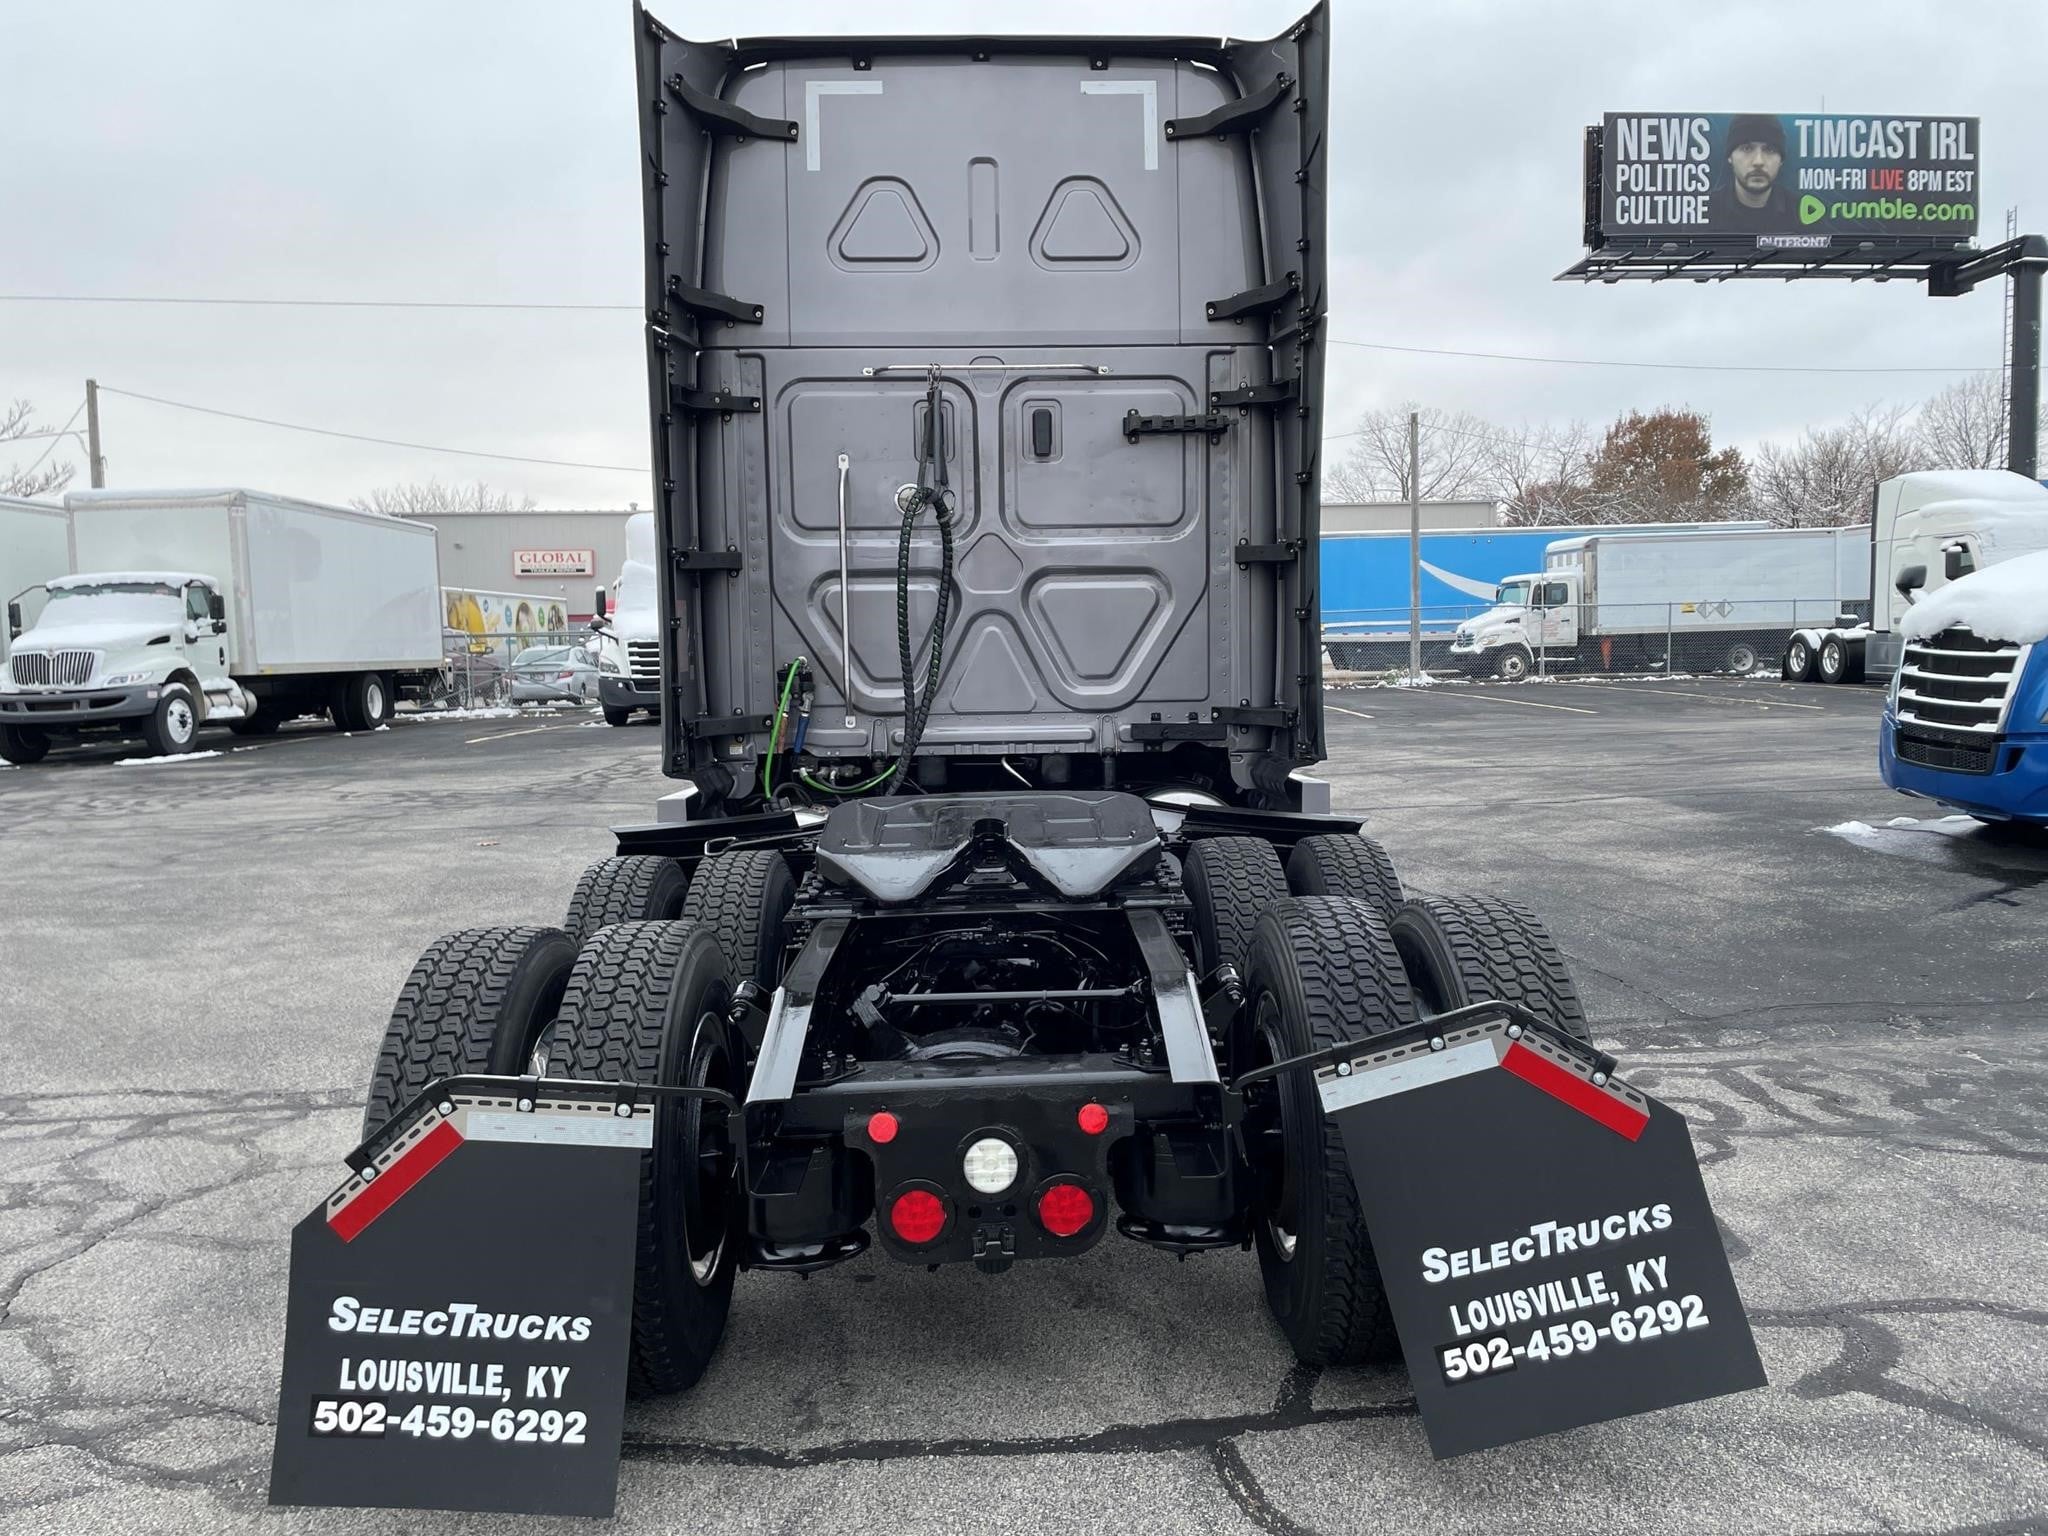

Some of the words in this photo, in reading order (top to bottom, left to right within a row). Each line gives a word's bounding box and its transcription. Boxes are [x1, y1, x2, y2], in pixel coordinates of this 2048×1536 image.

[1617, 118, 1710, 161] NEWS
[1794, 119, 1922, 160] TIMCAST
[1929, 121, 1975, 160] IRL
[1616, 163, 1710, 192] POLITICS
[1799, 168, 1867, 190] MON-FRI
[1871, 169, 1904, 190] LIVE
[1907, 169, 1942, 191] 8PM
[1945, 170, 1975, 192] EST
[1615, 195, 1710, 224] CULTURE
[1830, 198, 1975, 221] rumble.com
[519, 552, 586, 563] GLOBAL
[1449, 1270, 1620, 1336] LOUISVILLE,
[1626, 1256, 1669, 1295] KY
[1443, 1294, 1710, 1379] 502-459-6292
[339, 1357, 512, 1403] LOUISVILLE,
[525, 1365, 571, 1398] KY
[313, 1400, 588, 1444] 502-459-6292
